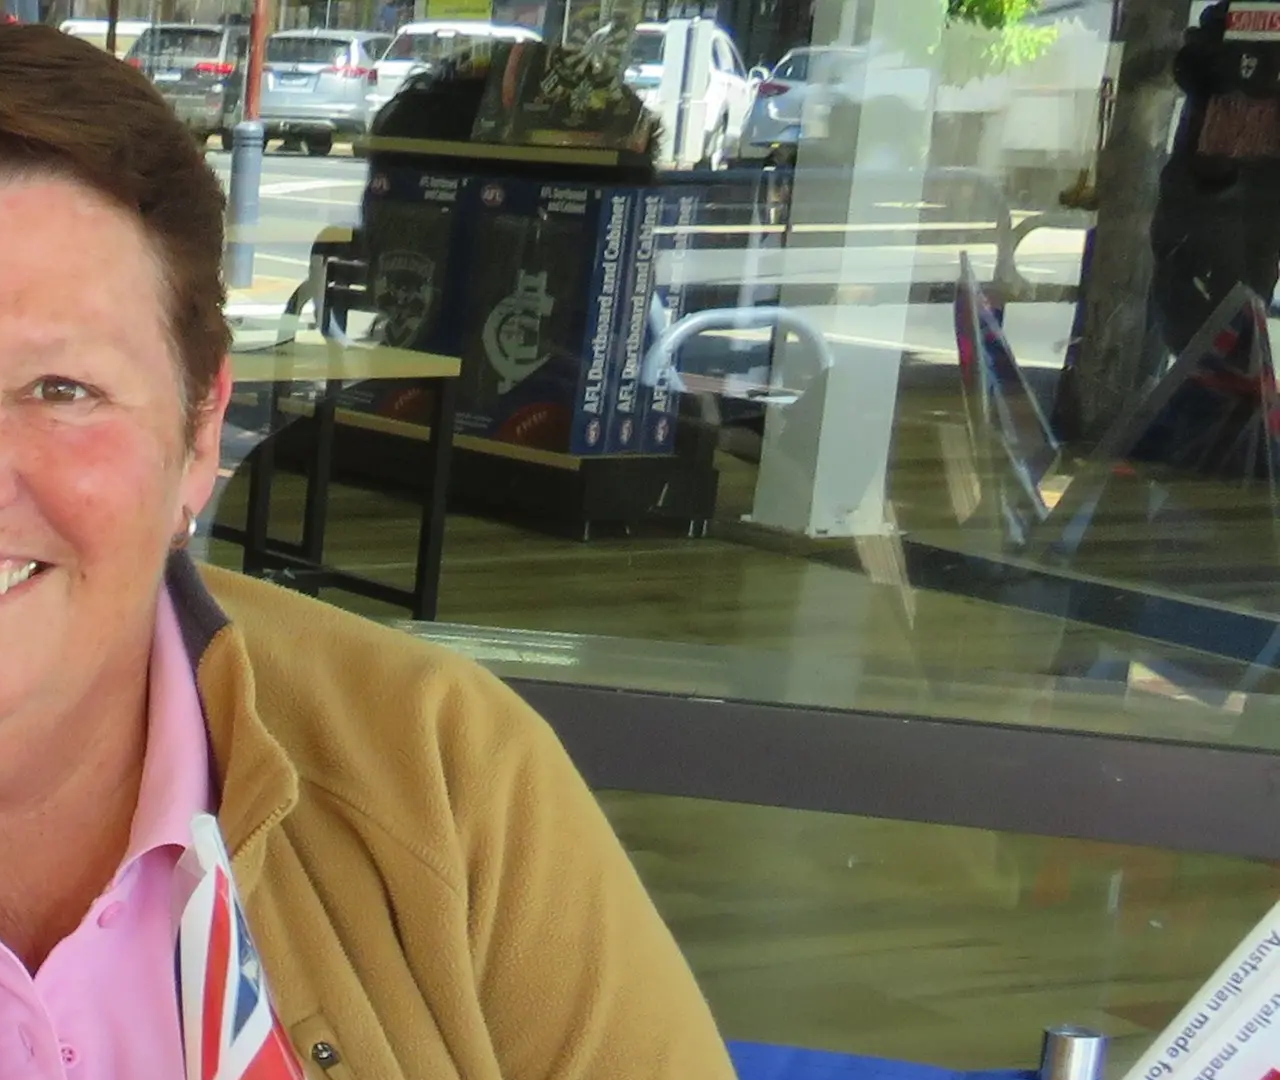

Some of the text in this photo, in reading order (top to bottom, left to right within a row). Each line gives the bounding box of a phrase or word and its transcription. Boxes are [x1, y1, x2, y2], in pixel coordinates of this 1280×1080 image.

[583, 196, 628, 413] AFL Dartboard and Cabinet
[617, 196, 661, 412] AFL Dartboard and Cabinet
[1169, 1011, 1209, 1060] made
